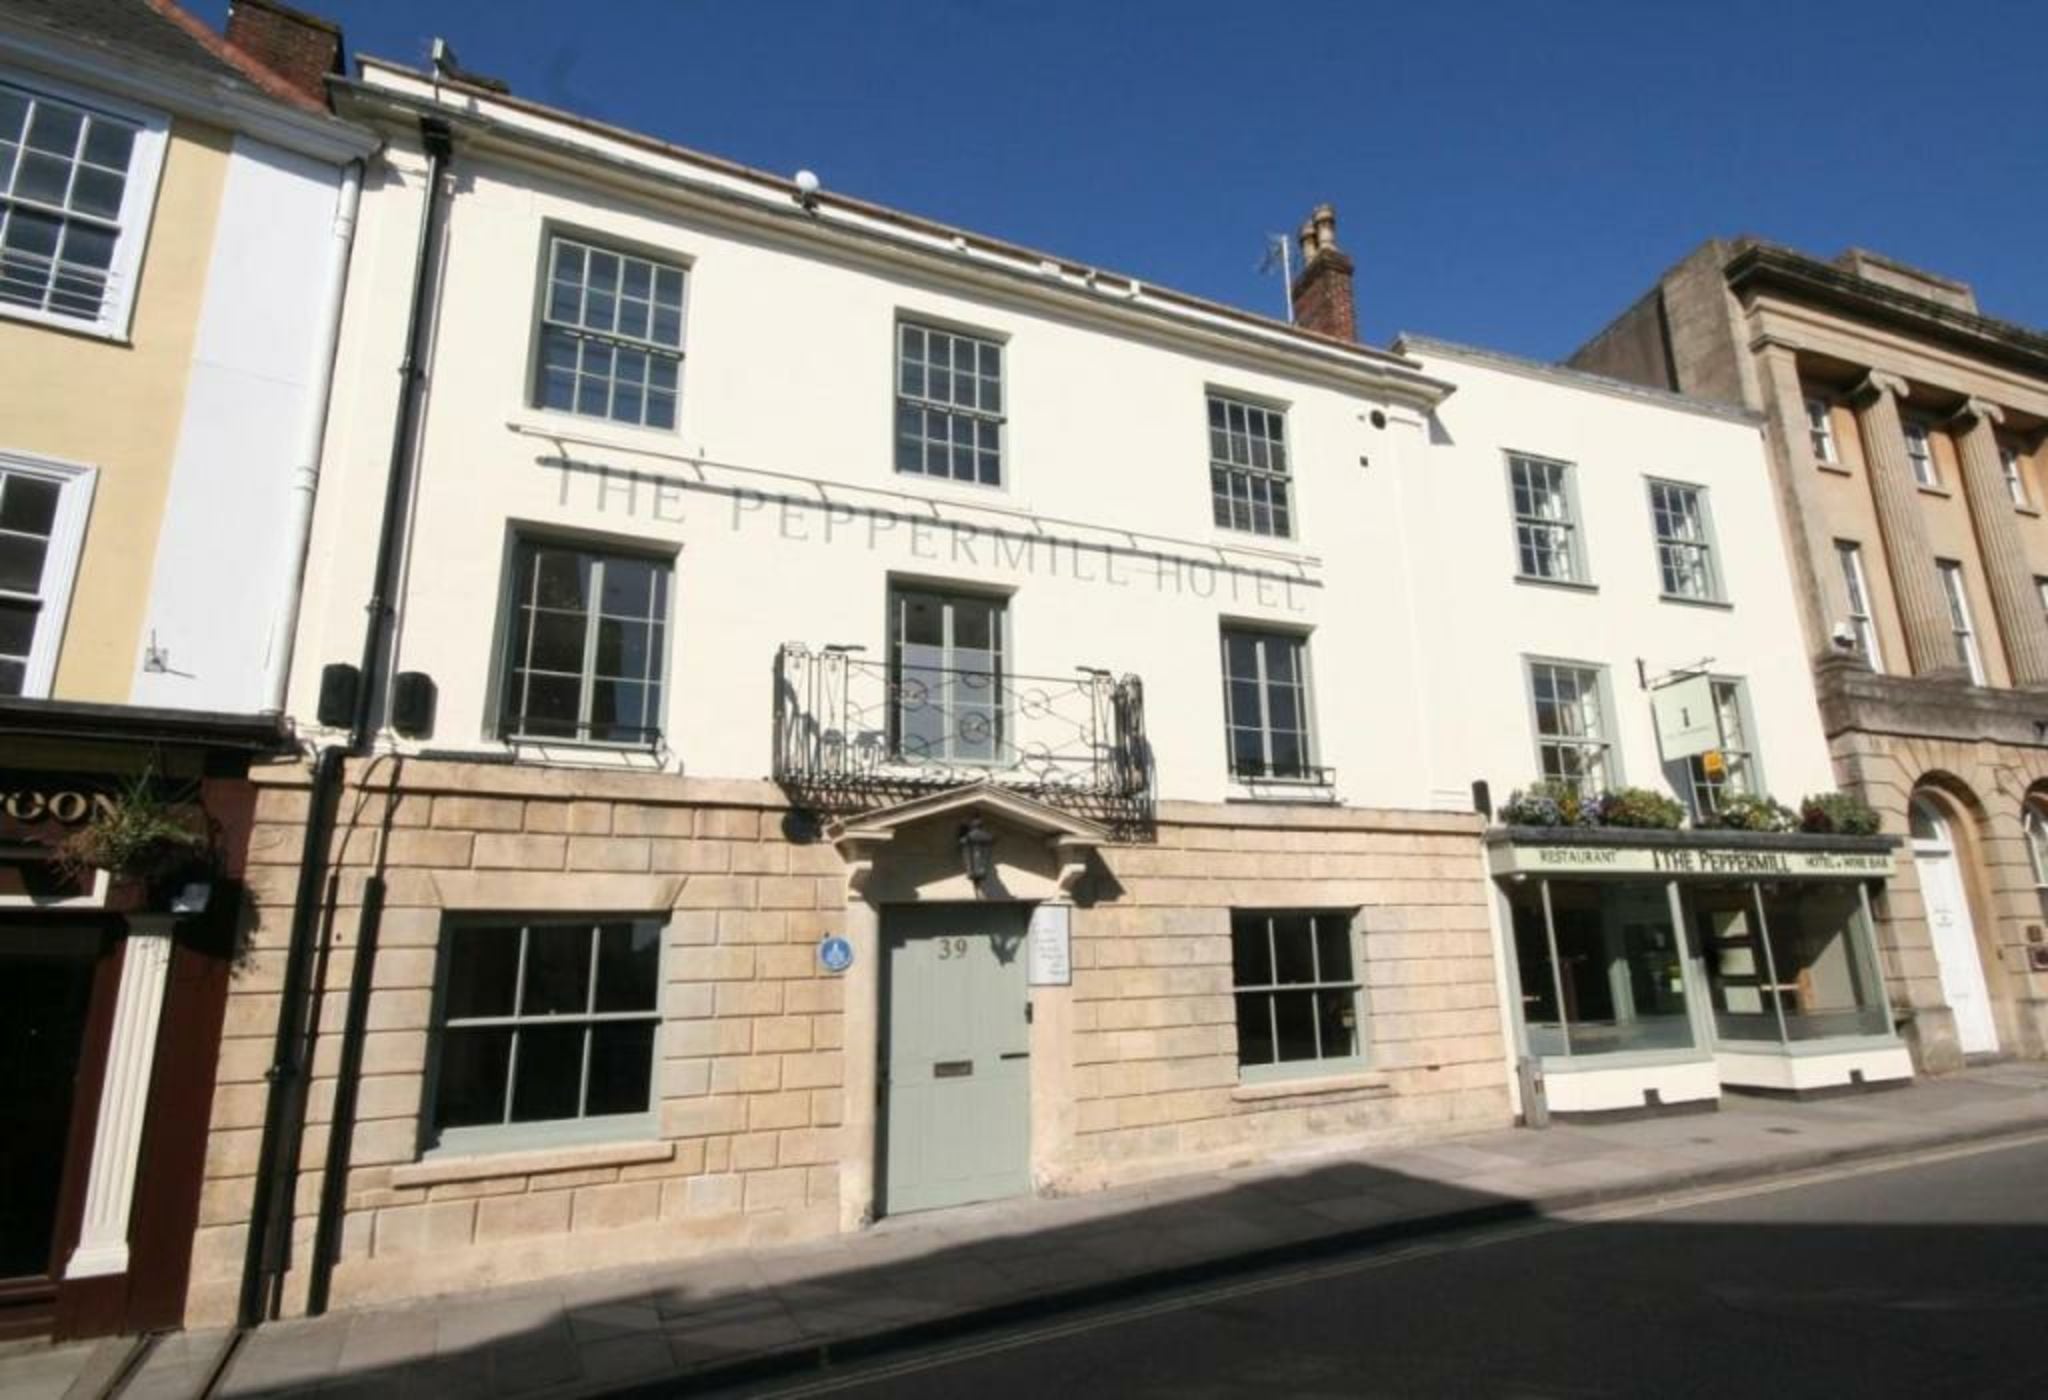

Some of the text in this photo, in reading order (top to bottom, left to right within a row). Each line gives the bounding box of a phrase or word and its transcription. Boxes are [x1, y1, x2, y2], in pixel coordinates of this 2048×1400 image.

[549, 462, 1305, 612] THE PEPPERMILL HOTEL
[0, 791, 125, 823] OON
[1539, 848, 1618, 864] RESTAURANT
[1661, 849, 1694, 871] THE
[1699, 849, 1792, 873] PEPPERMILL
[938, 938, 968, 960] 39
